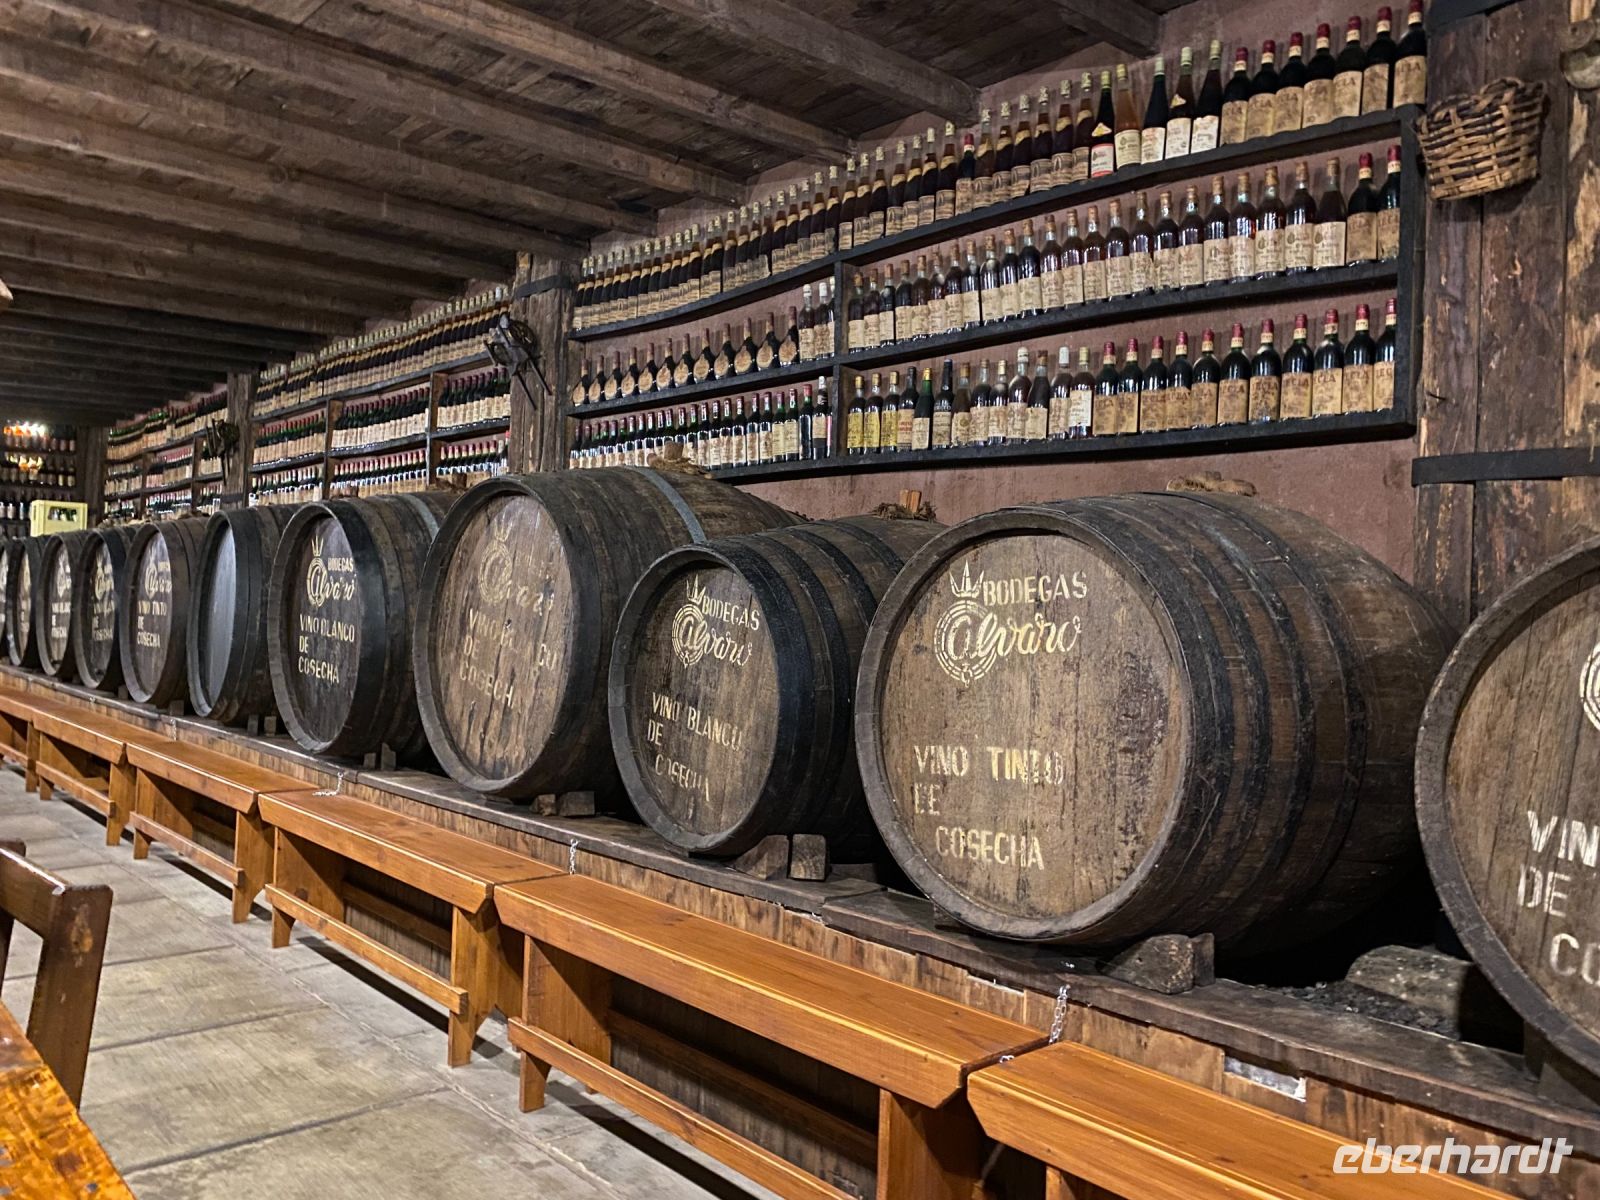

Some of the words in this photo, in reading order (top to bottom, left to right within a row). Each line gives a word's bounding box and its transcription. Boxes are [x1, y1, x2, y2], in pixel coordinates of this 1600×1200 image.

[983, 571, 1088, 606] BODEGAS
[300, 613, 319, 633] VINO
[321, 618, 355, 643] BLANCO
[702, 595, 760, 631] BODEGAS
[299, 635, 309, 653] DE
[680, 615, 753, 666] Alvaro
[948, 612, 1082, 661] Alvaro
[298, 655, 339, 684] COSECHA
[652, 691, 680, 721] VINO
[647, 719, 664, 746] DE
[914, 745, 969, 777] VINO
[986, 746, 1064, 785] TINTO
[914, 782, 942, 816] DE
[935, 825, 1045, 870] COSECHA
[1517, 863, 1571, 918] DE
